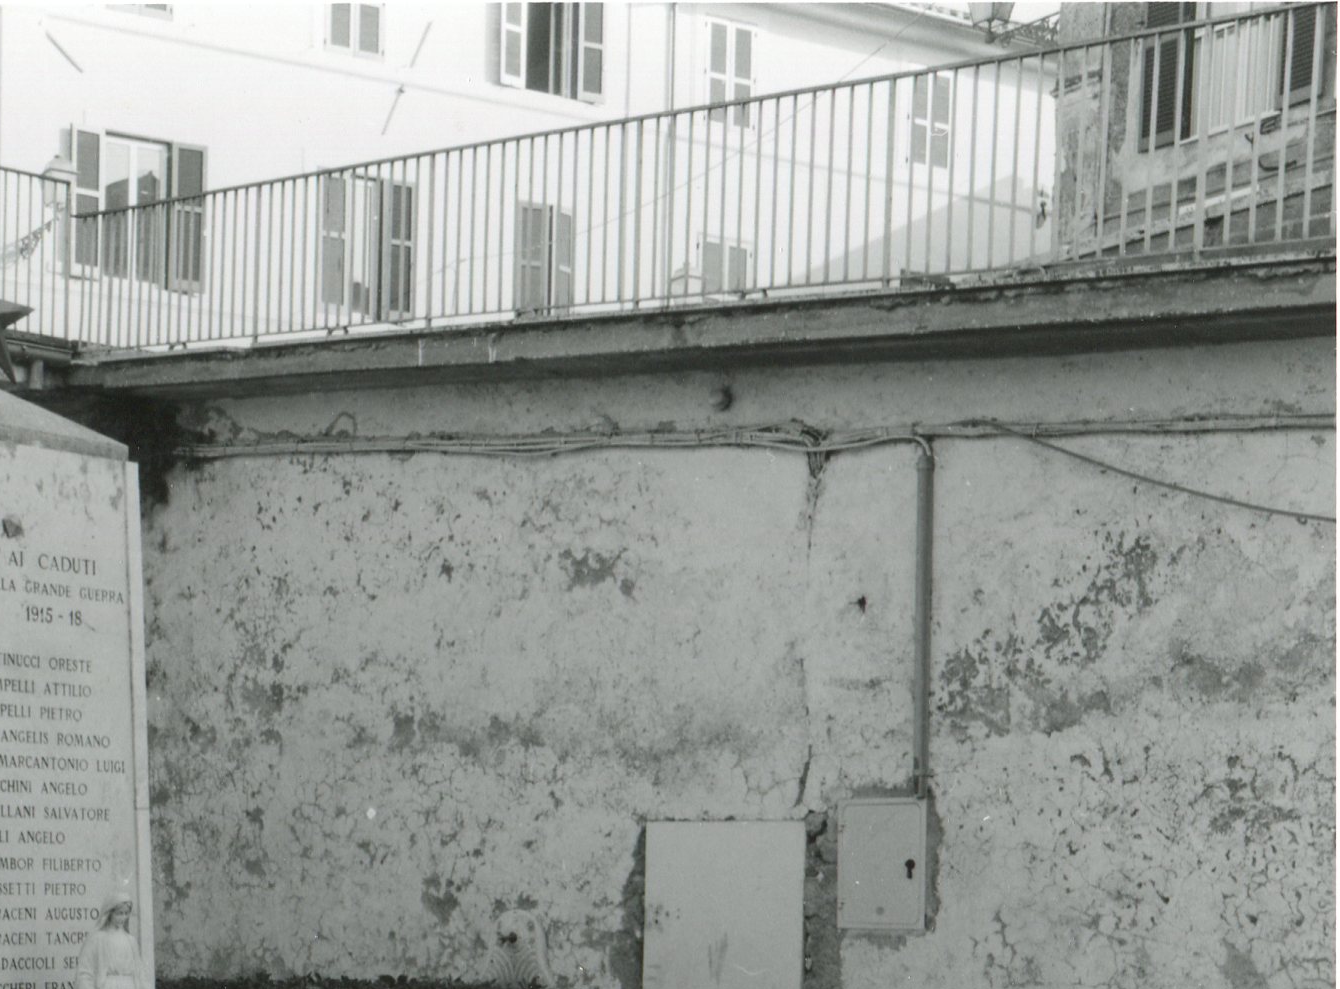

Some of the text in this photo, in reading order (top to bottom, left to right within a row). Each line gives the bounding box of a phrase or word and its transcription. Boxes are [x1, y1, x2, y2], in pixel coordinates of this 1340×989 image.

[8, 550, 96, 576] AI CADUTI
[24, 580, 71, 598] GRANDE
[79, 587, 124, 604] GUERRA
[26, 606, 53, 623] 1915
[69, 610, 82, 626] 18
[48, 657, 92, 673] ORESTE
[44, 682, 92, 698] ATTILIO
[40, 706, 82, 722] PIETRO
[0, 730, 49, 745] ANGELIS
[56, 733, 111, 748] ROMANO
[96, 759, 126, 774] LUIGI
[40, 782, 88, 796] ANGELO
[44, 806, 110, 822] SALVATORE
[18, 830, 66, 845] ANGELO
[42, 858, 102, 872] FILIBERTO
[44, 882, 86, 896] PIETRO
[44, 908, 100, 921] AUGUSTO
